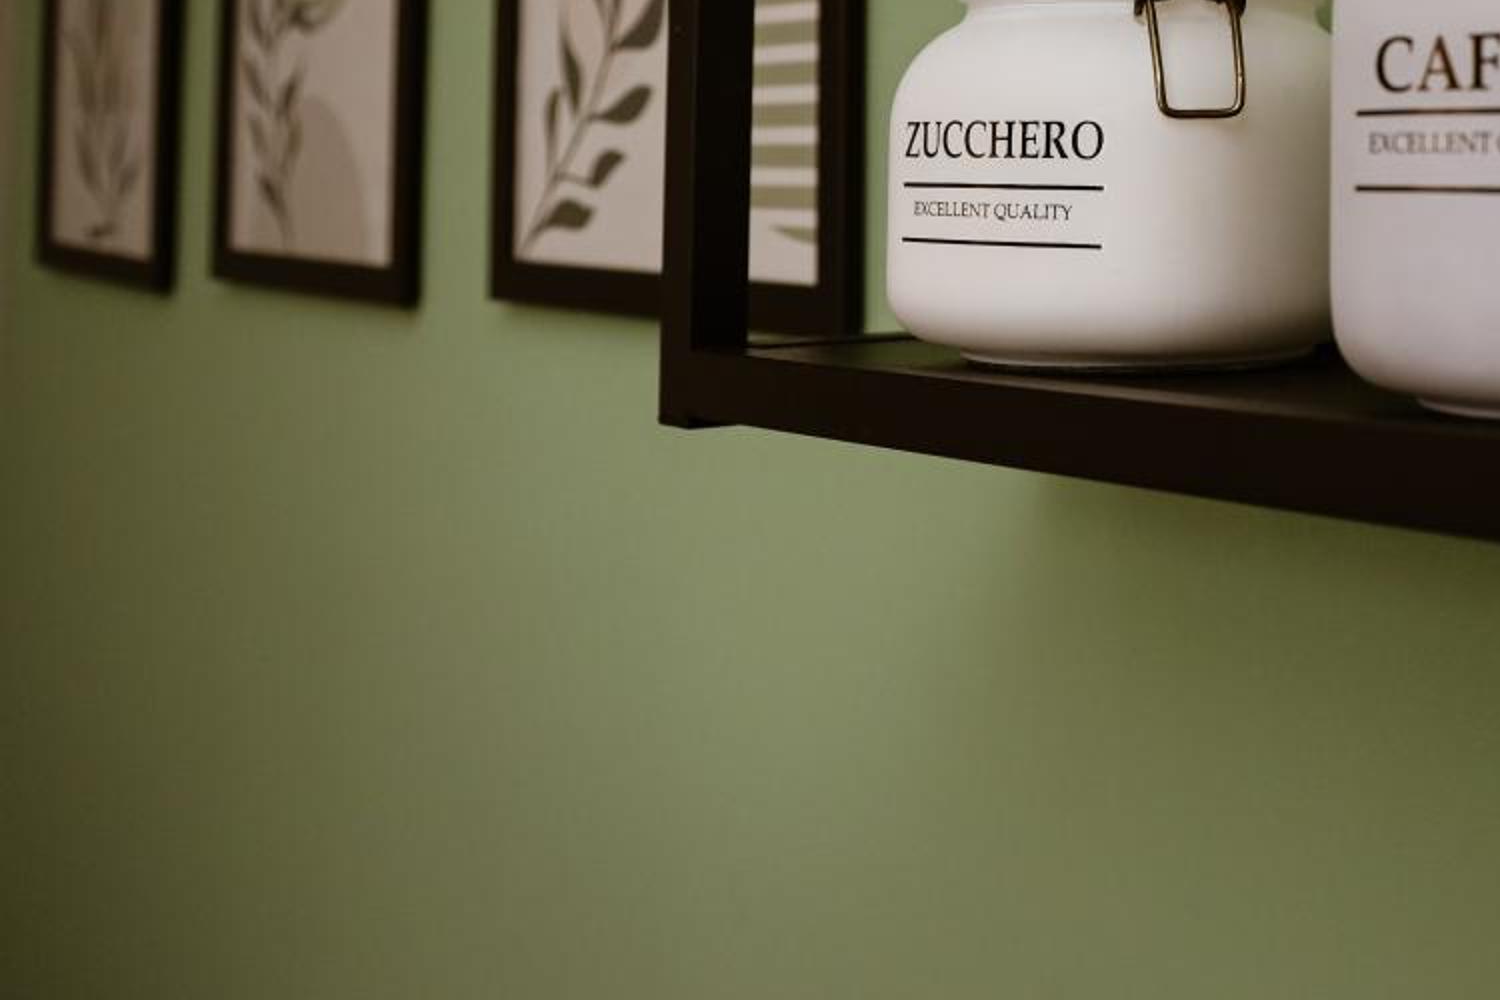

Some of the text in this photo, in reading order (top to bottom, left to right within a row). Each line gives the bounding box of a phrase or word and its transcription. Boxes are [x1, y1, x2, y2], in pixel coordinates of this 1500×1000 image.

[904, 119, 1105, 160] ZUCCHERO
[1368, 131, 1491, 154] EXCELLENT
[913, 200, 1073, 221] EXCELLENT QUALITY
